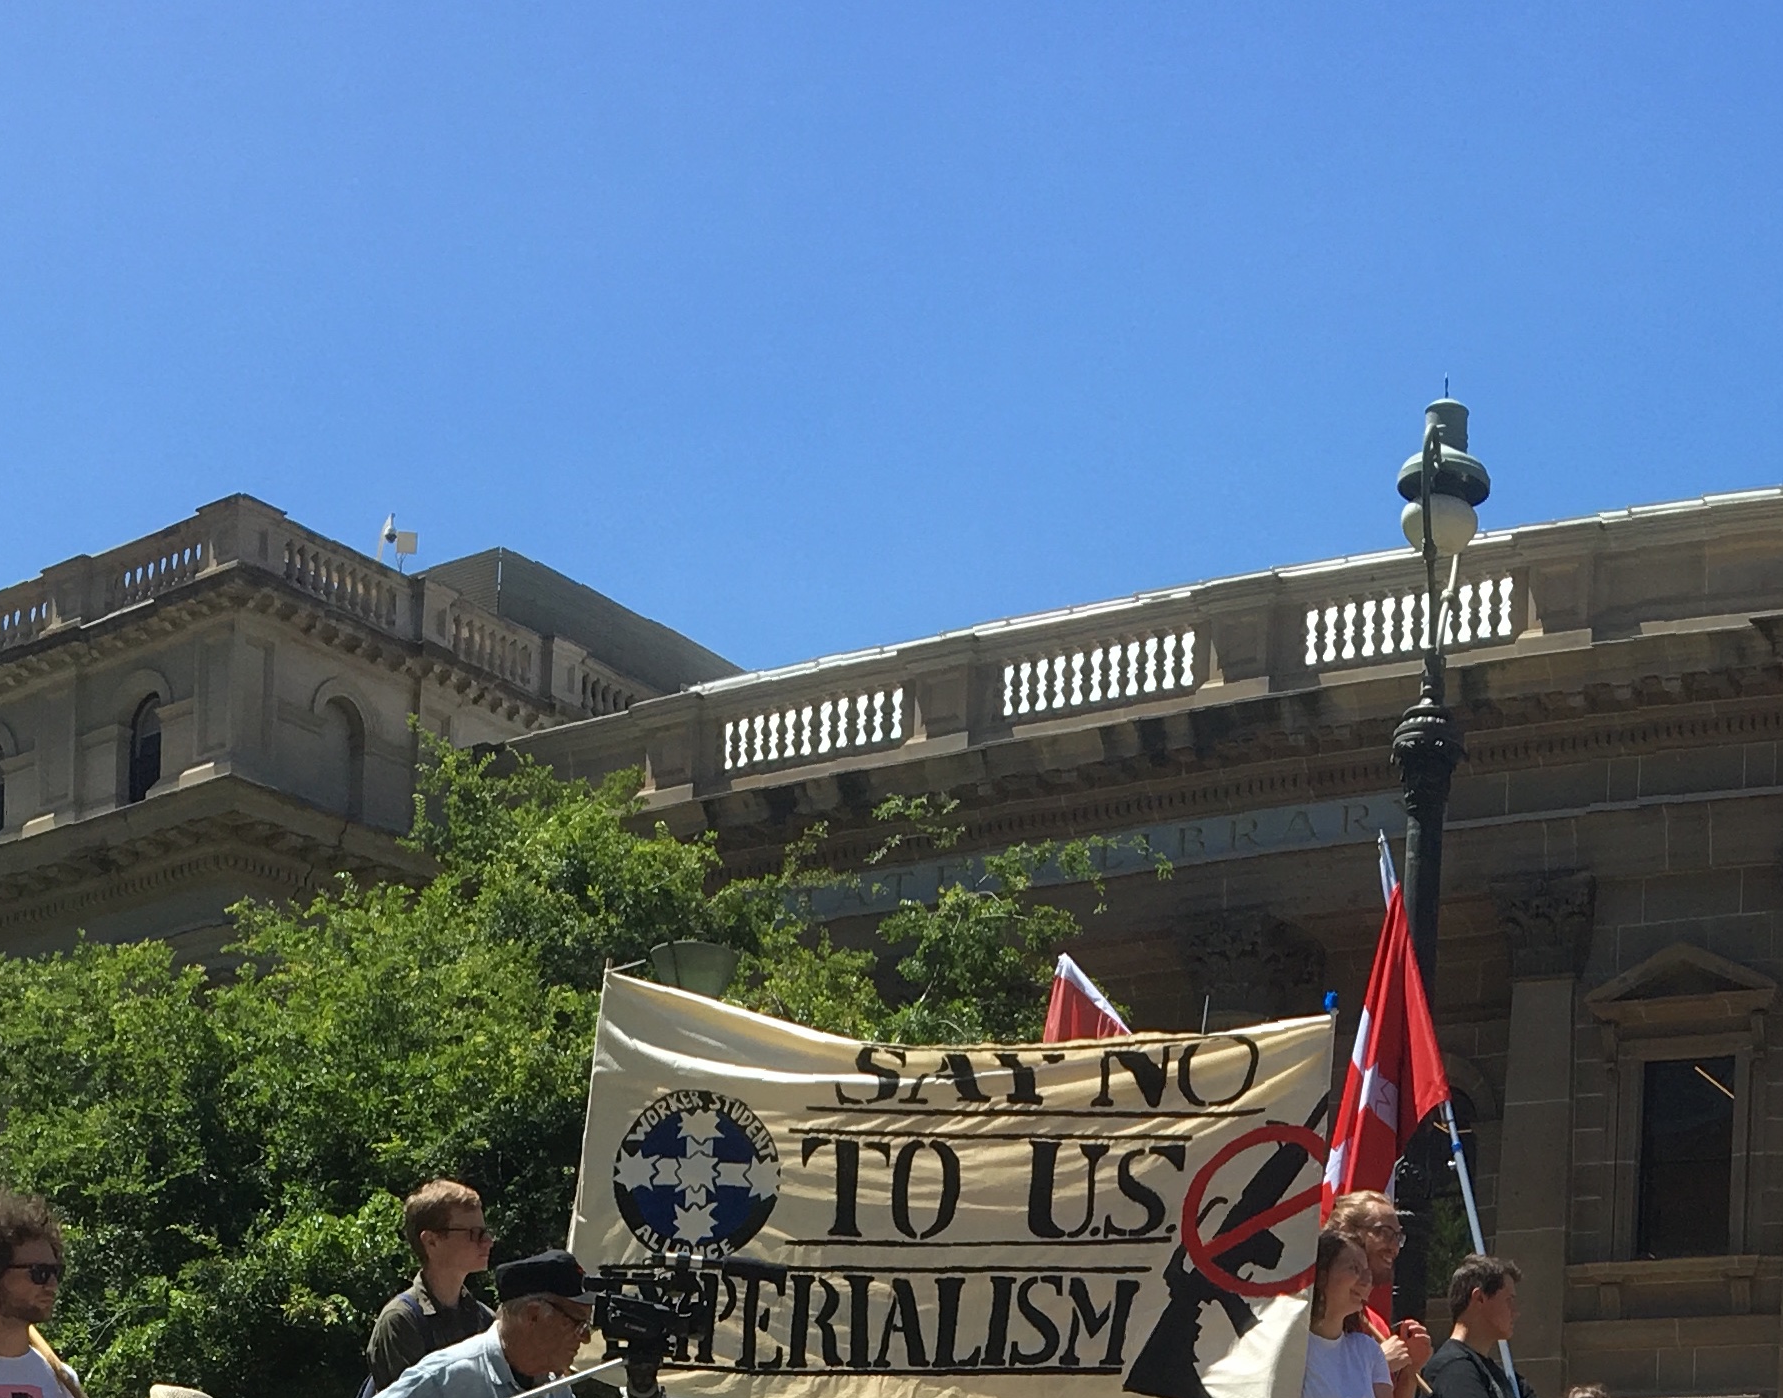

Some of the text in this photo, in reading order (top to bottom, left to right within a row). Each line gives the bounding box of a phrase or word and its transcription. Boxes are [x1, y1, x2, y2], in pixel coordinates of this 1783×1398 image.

[835, 1034, 1260, 1109] SAY NO
[626, 1090, 776, 1163] WORKER STUDENT
[802, 1136, 1185, 1240] TO U.S.
